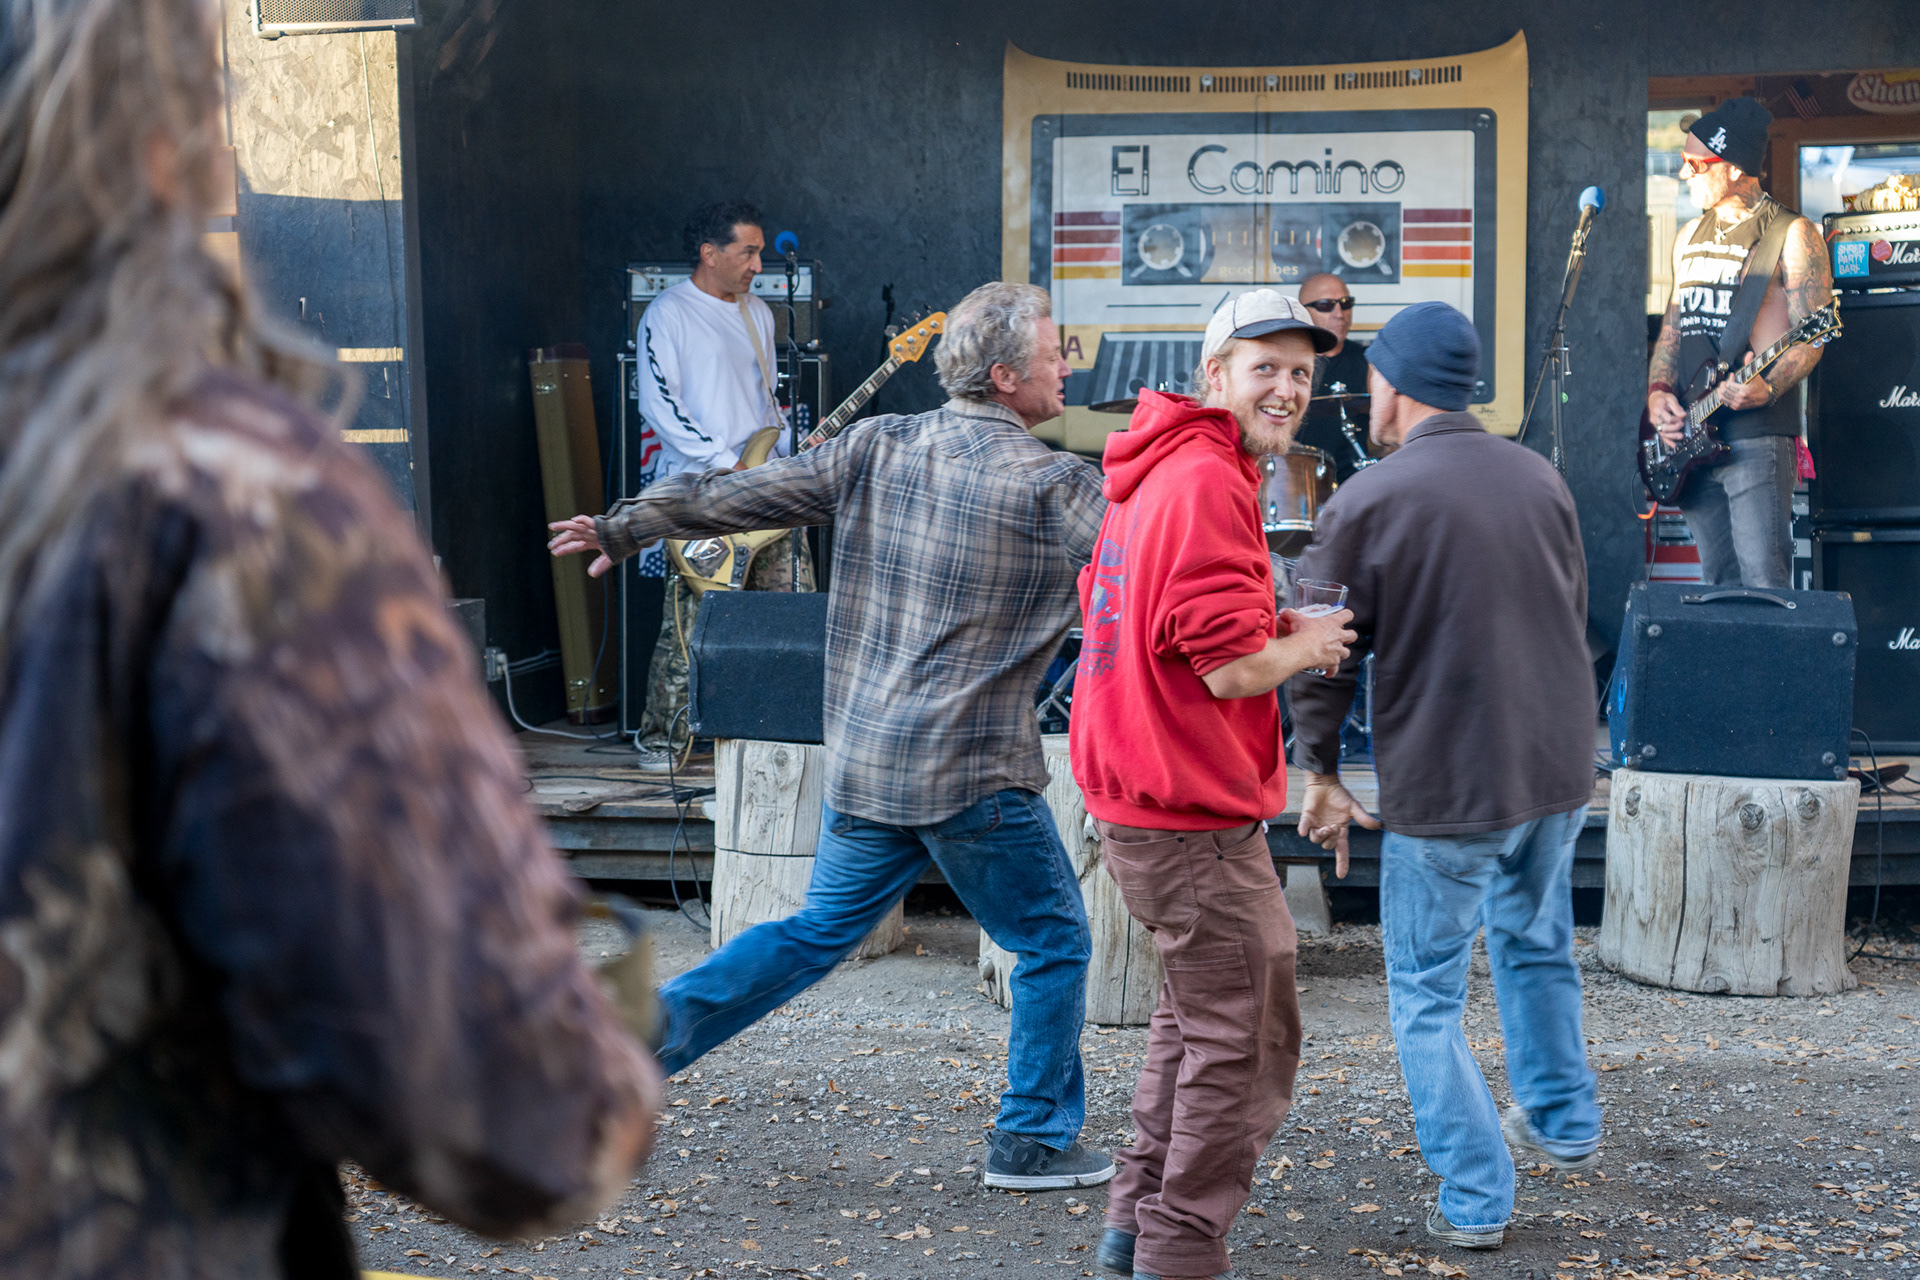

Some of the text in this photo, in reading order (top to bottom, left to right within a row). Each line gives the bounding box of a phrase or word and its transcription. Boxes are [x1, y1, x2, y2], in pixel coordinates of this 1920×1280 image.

[1708, 126, 1727, 154] LA
[1111, 144, 1405, 196] El Camino
[1879, 385, 1920, 408] Mar
